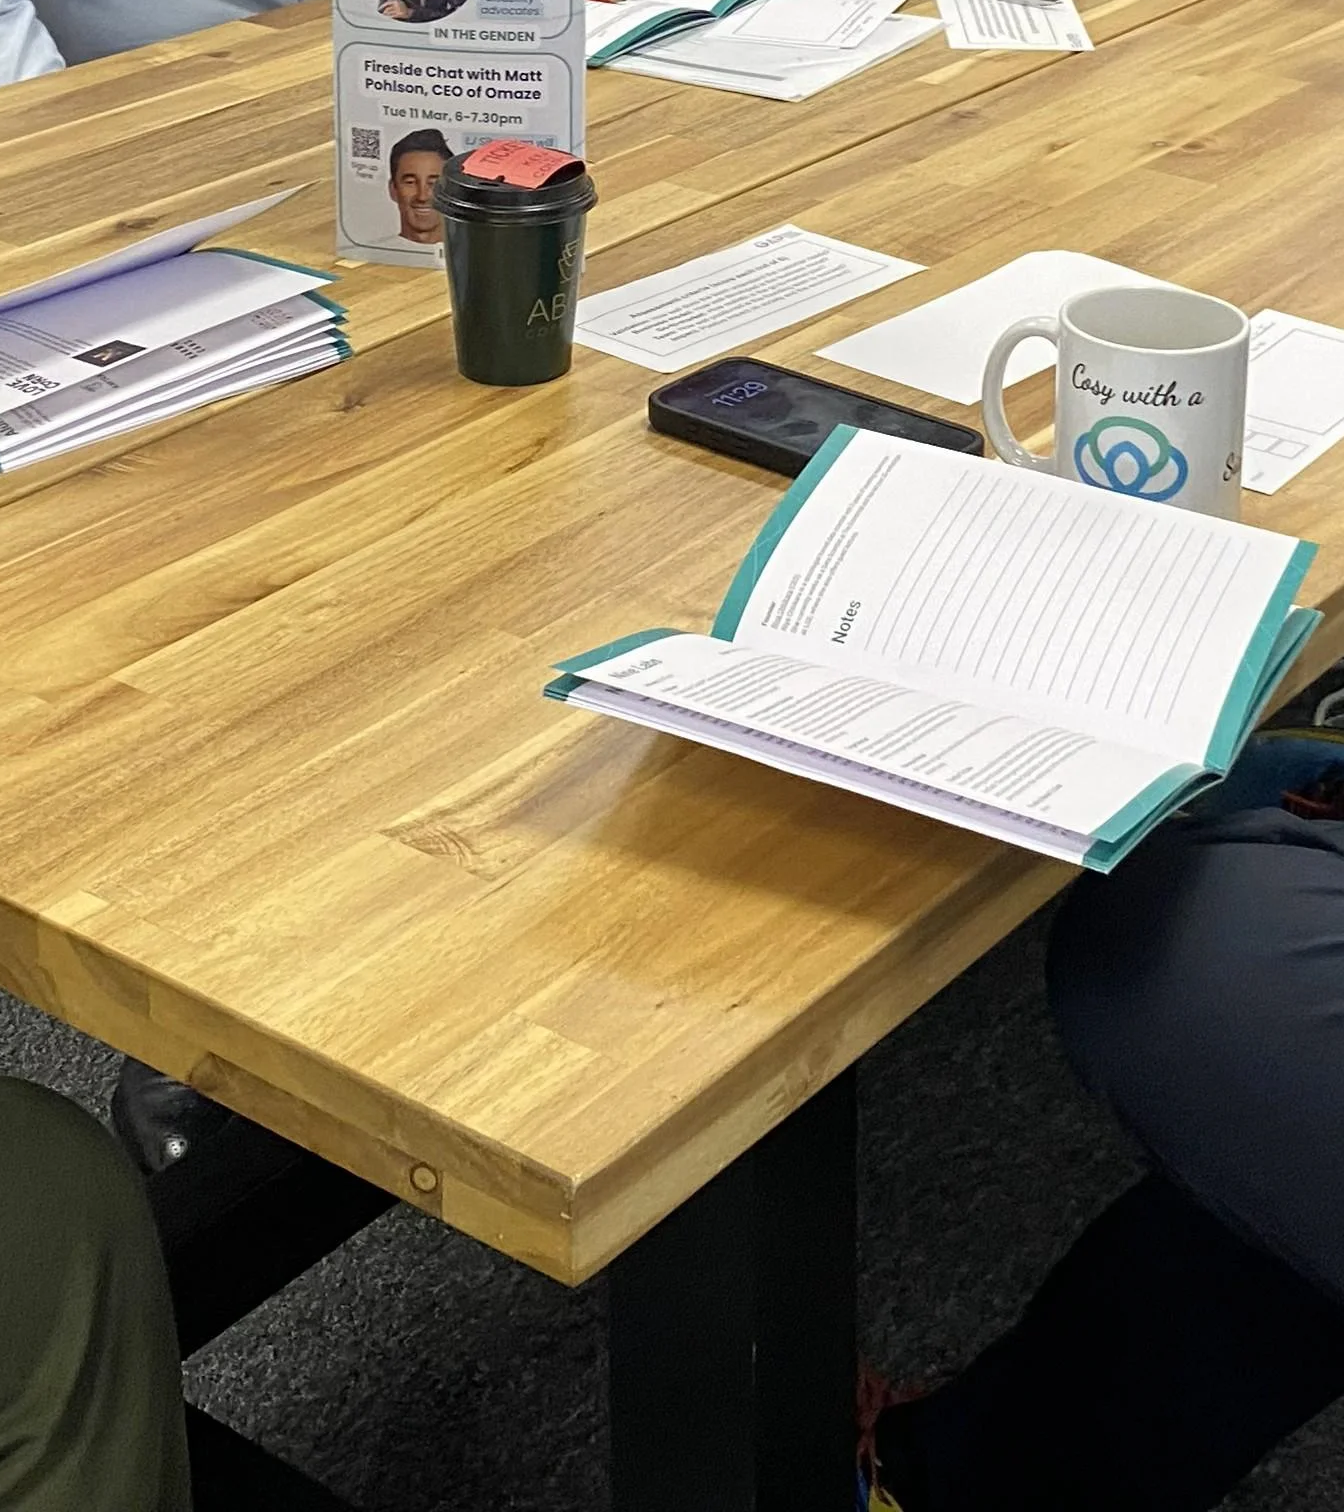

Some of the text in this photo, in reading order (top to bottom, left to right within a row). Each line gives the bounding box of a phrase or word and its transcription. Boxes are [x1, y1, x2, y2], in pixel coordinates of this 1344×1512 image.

[434, 28, 535, 42] IN THE GENDEN
[364, 60, 543, 82] Fireside Chat with Matt
[365, 78, 541, 100] Pohlson, CEO of Omaze
[382, 106, 406, 118] Tue
[410, 108, 419, 118] 11
[422, 109, 452, 122] Mar,
[5, 379, 46, 396] LOVE
[711, 381, 768, 407] 11:29
[1072, 363, 1204, 406] Cosy with a
[831, 600, 861, 644] Notes
